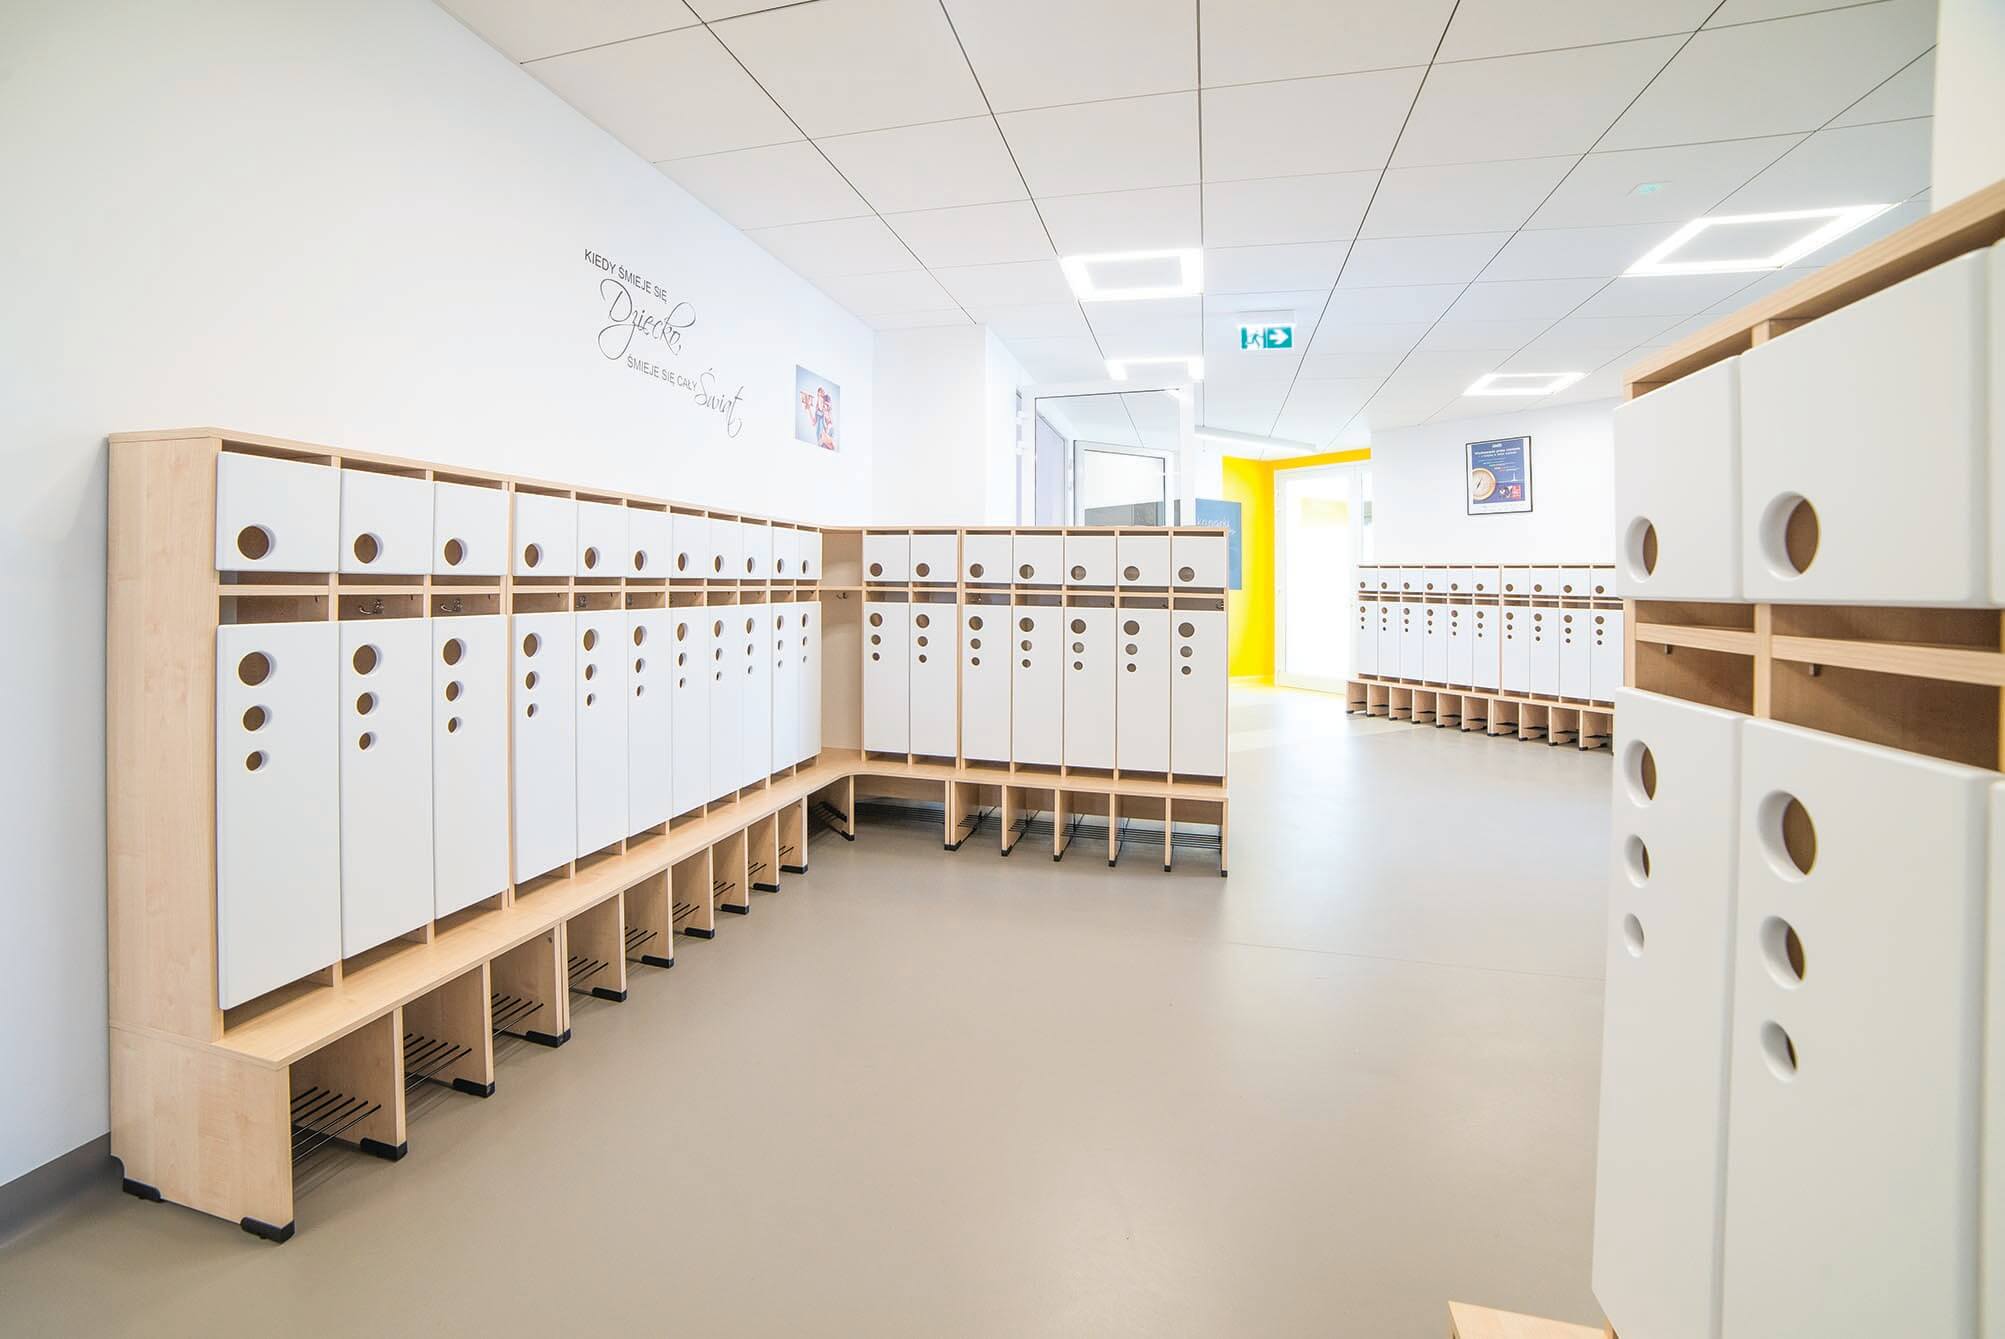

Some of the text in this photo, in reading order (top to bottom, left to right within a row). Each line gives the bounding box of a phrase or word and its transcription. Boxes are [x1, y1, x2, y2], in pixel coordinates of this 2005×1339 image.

[584, 249, 668, 303] KIEDY ŚMIEJE SIĘ
[627, 353, 744, 438] ŚMIEJE SIĘ CAŁY Świat
